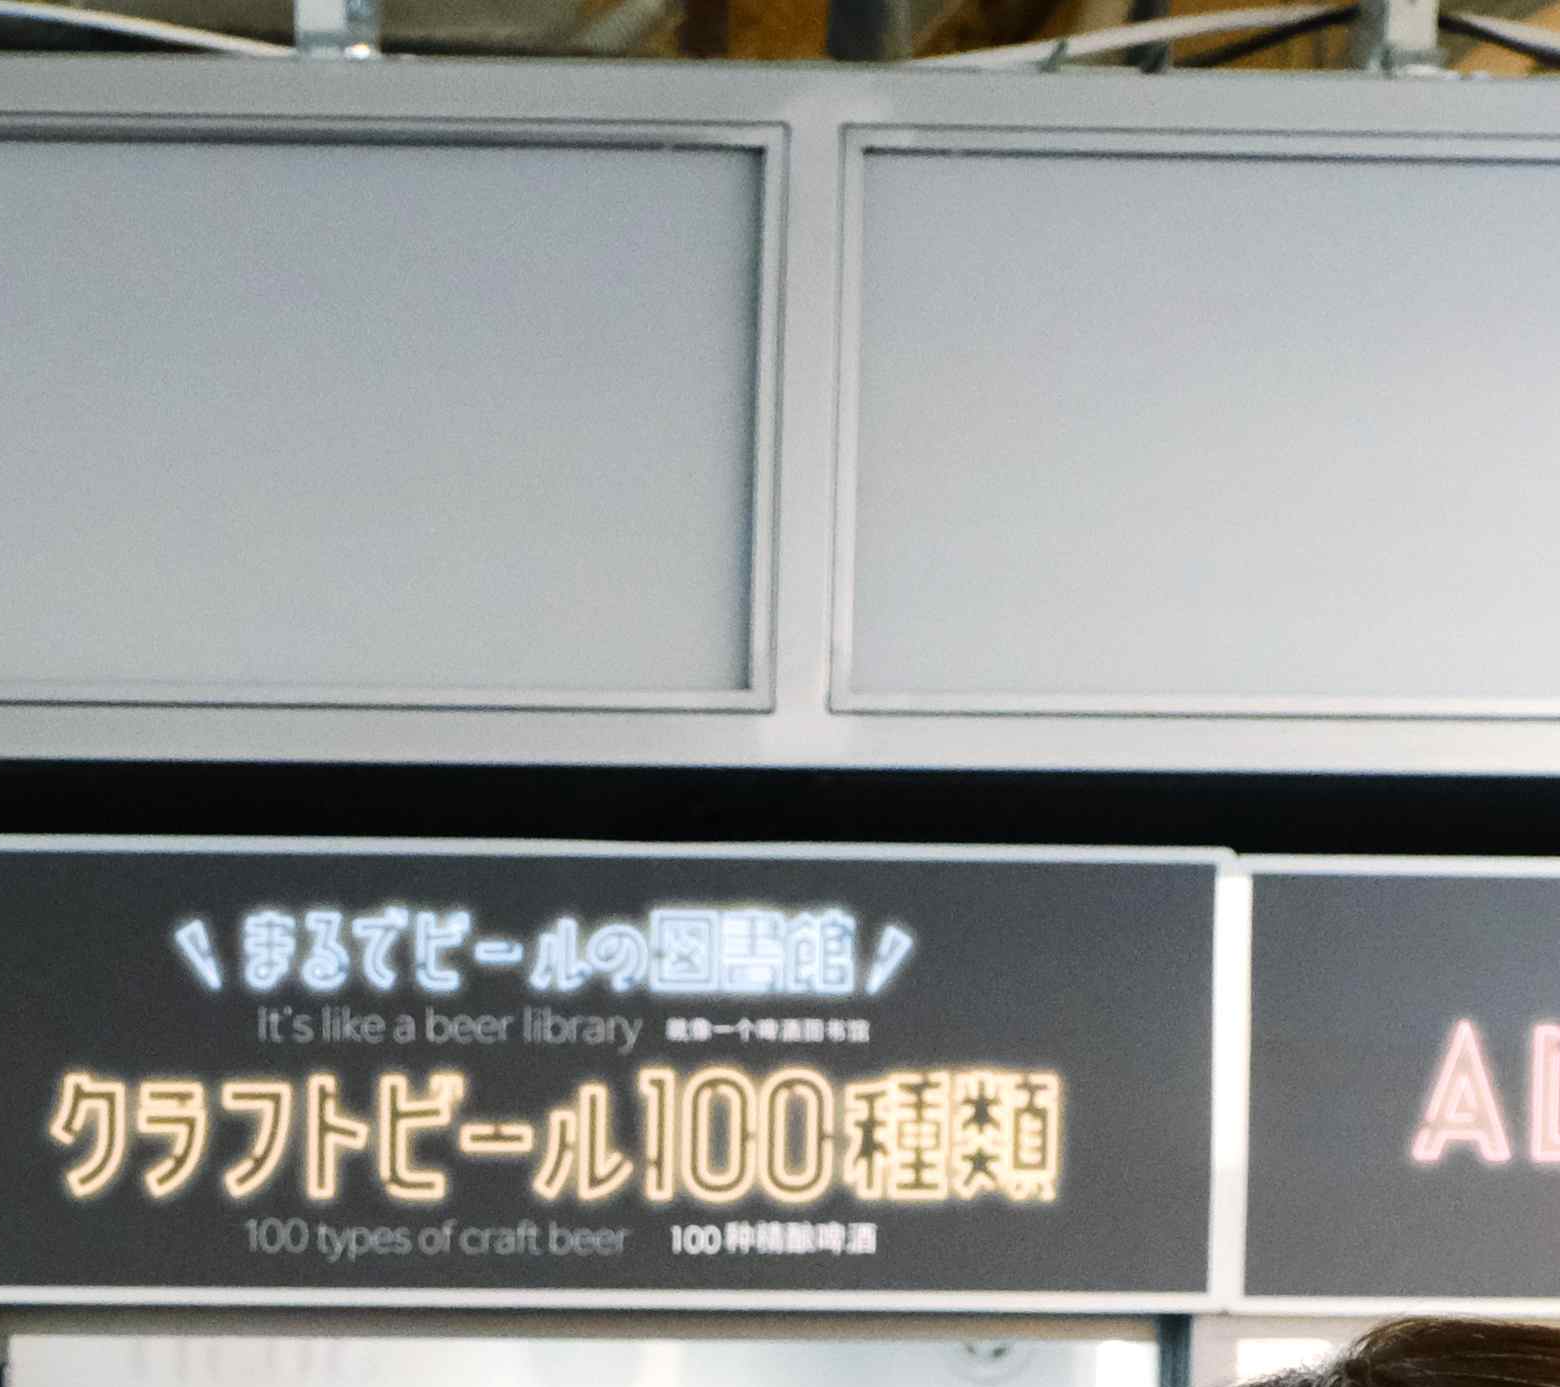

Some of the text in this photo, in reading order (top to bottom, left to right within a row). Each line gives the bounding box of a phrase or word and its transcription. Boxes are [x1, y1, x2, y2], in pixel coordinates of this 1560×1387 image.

[240, 906, 857, 994] まるでビールの図書館
[257, 1005, 644, 1055] It's like a beer library
[50, 1066, 1062, 1204] クラフトビール100種類
[245, 1216, 630, 1261] 100 types of craft beer
